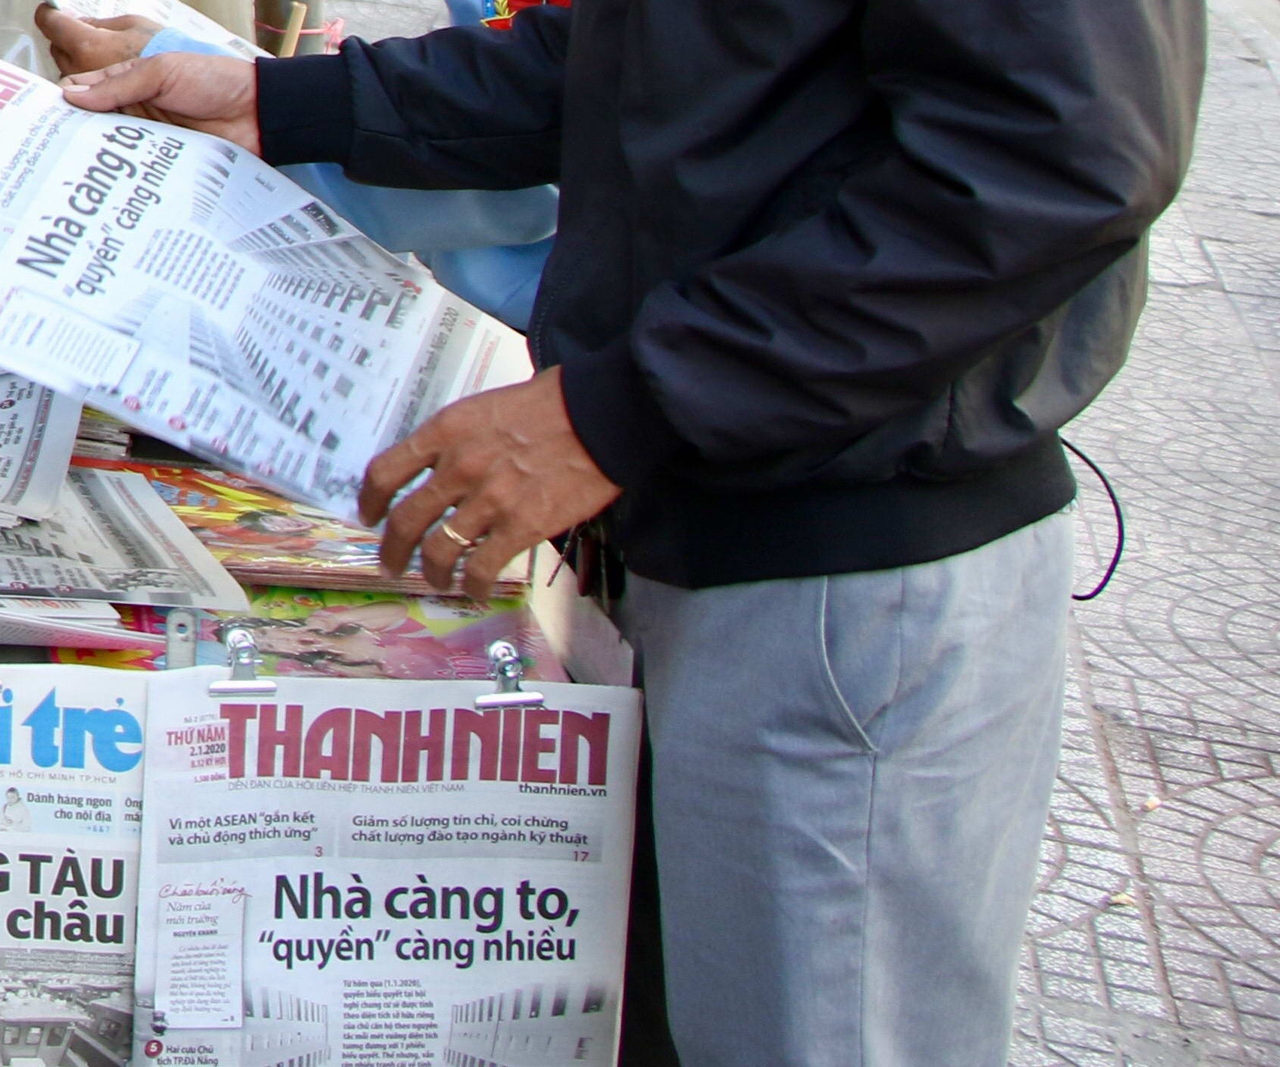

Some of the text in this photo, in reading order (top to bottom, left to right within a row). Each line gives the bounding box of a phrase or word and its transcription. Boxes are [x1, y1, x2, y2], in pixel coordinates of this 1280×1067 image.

[16, 147, 137, 279] Nhà càng
[113, 184, 162, 231] càng
[21, 686, 144, 773] trẻ
[167, 725, 226, 747] THỨ NĂM
[190, 743, 227, 757] 2.1.2020
[27, 791, 113, 811] Dành hàng ngon
[519, 783, 608, 798] thanhnien.vn
[214, 812, 258, 828] ASEAN
[293, 809, 316, 825] kết
[351, 814, 570, 833] Giảm lượng chừng
[213, 830, 247, 847] động
[249, 828, 282, 842] thích
[351, 829, 590, 847] chất lượng tạo ngành thuật
[573, 850, 590, 864] 17
[18, 847, 125, 899] TÀU
[273, 871, 581, 933] Nhà càng to,
[6, 898, 125, 945] châu
[395, 927, 475, 969] càng
[483, 924, 577, 963] nhiều
